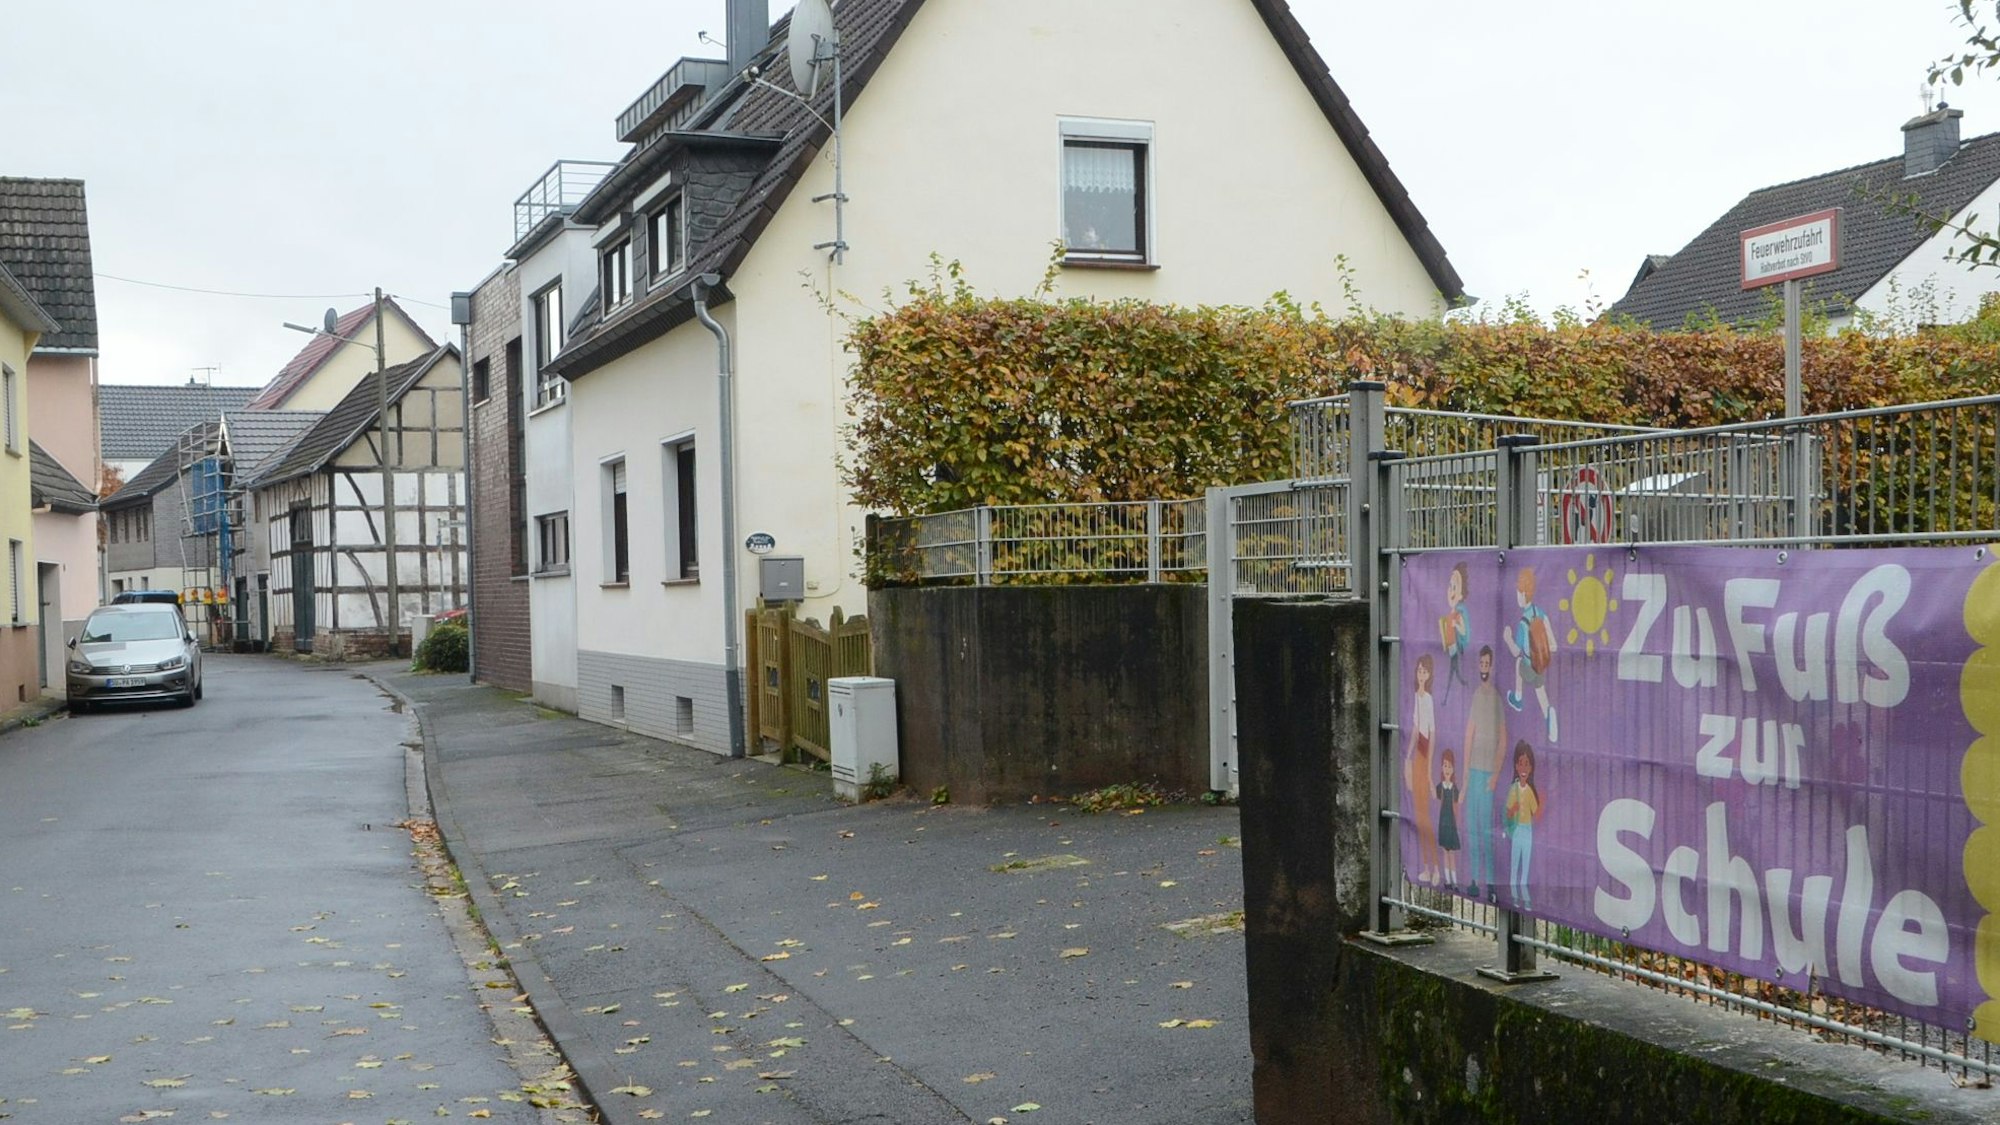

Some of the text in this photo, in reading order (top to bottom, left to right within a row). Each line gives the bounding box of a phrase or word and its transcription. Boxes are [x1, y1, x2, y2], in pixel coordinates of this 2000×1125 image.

[1751, 227, 1823, 260] Feuerwehrzufahrt
[1786, 257, 1800, 268] nach
[1617, 563, 1912, 708] Zu Fuß
[1696, 713, 1806, 789] zur
[1593, 798, 1950, 1007] Schule
